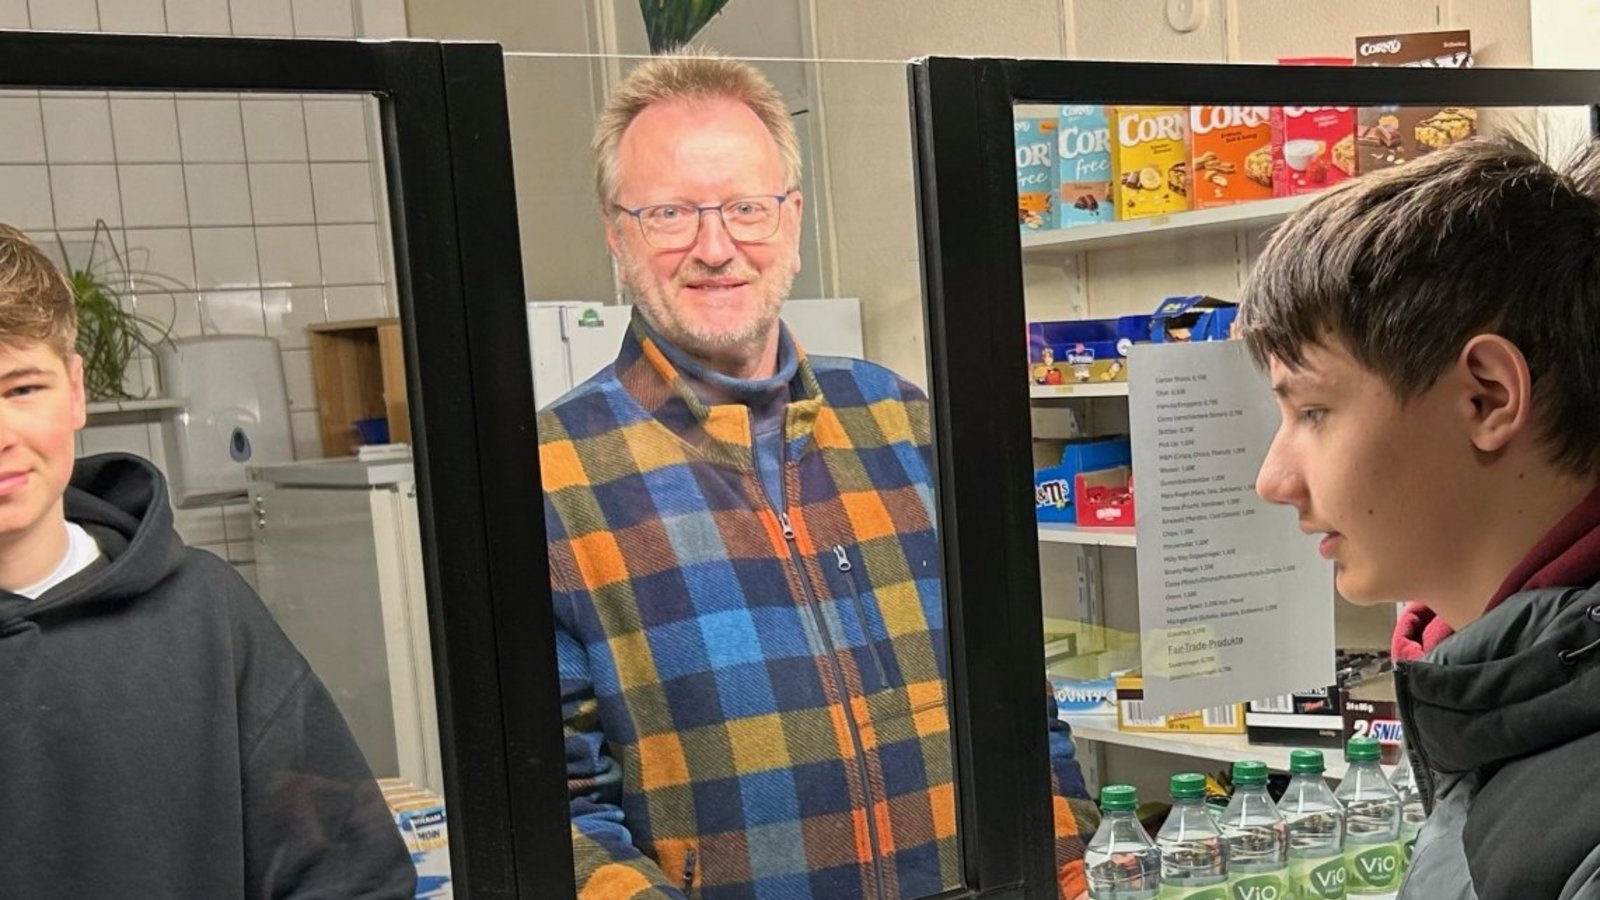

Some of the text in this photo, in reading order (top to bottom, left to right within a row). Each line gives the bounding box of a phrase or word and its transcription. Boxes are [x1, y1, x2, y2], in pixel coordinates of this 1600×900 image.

[1360, 39, 1402, 56] CORNY
[1074, 158, 1110, 180] free
[1056, 687, 1102, 703] OUNTY
